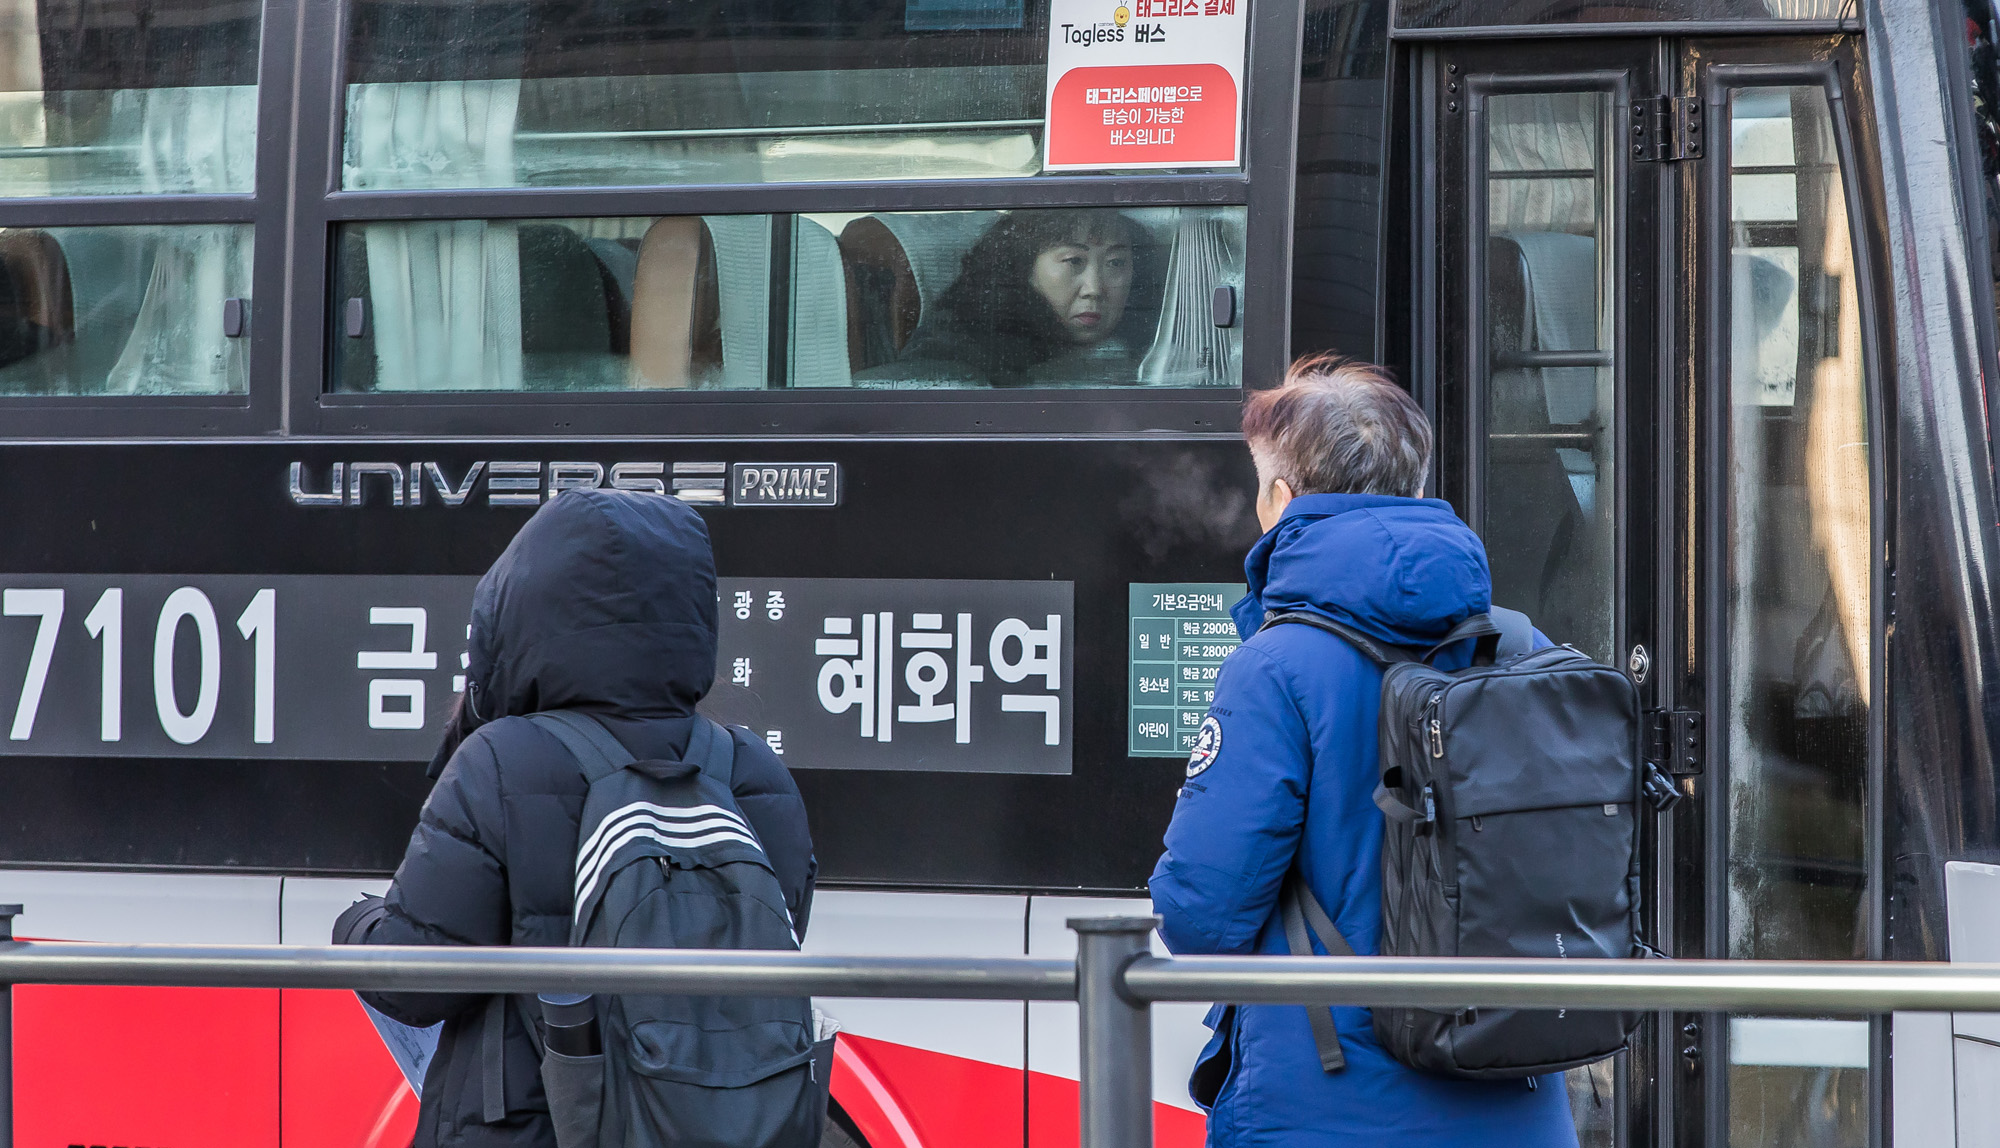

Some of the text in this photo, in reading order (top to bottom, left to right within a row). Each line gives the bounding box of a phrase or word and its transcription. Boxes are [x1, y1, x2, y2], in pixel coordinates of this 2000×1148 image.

[1136, 0, 1235, 17] 태그리스 결제
[1061, 23, 1124, 46] Tagless
[1135, 24, 1165, 43] 버스
[1085, 86, 1202, 104] 태그리스페이앱으로
[1102, 107, 1184, 125] 탑승이 가능한
[1110, 128, 1175, 145] 버스입니다
[741, 468, 830, 500] PRIME
[1152, 593, 1223, 611] 기본요금안내
[1183, 622, 1237, 636] 현금 2900원
[1182, 645, 1200, 658] 카드
[2, 586, 276, 744] 7101
[357, 607, 472, 729] 금
[1182, 667, 1200, 680] 현금
[815, 611, 1061, 746] 혜화역
[1138, 677, 1169, 693] 청소년
[1182, 690, 1215, 703] 카드 19
[1182, 712, 1200, 725] 현금
[1138, 722, 1169, 739] 어린이
